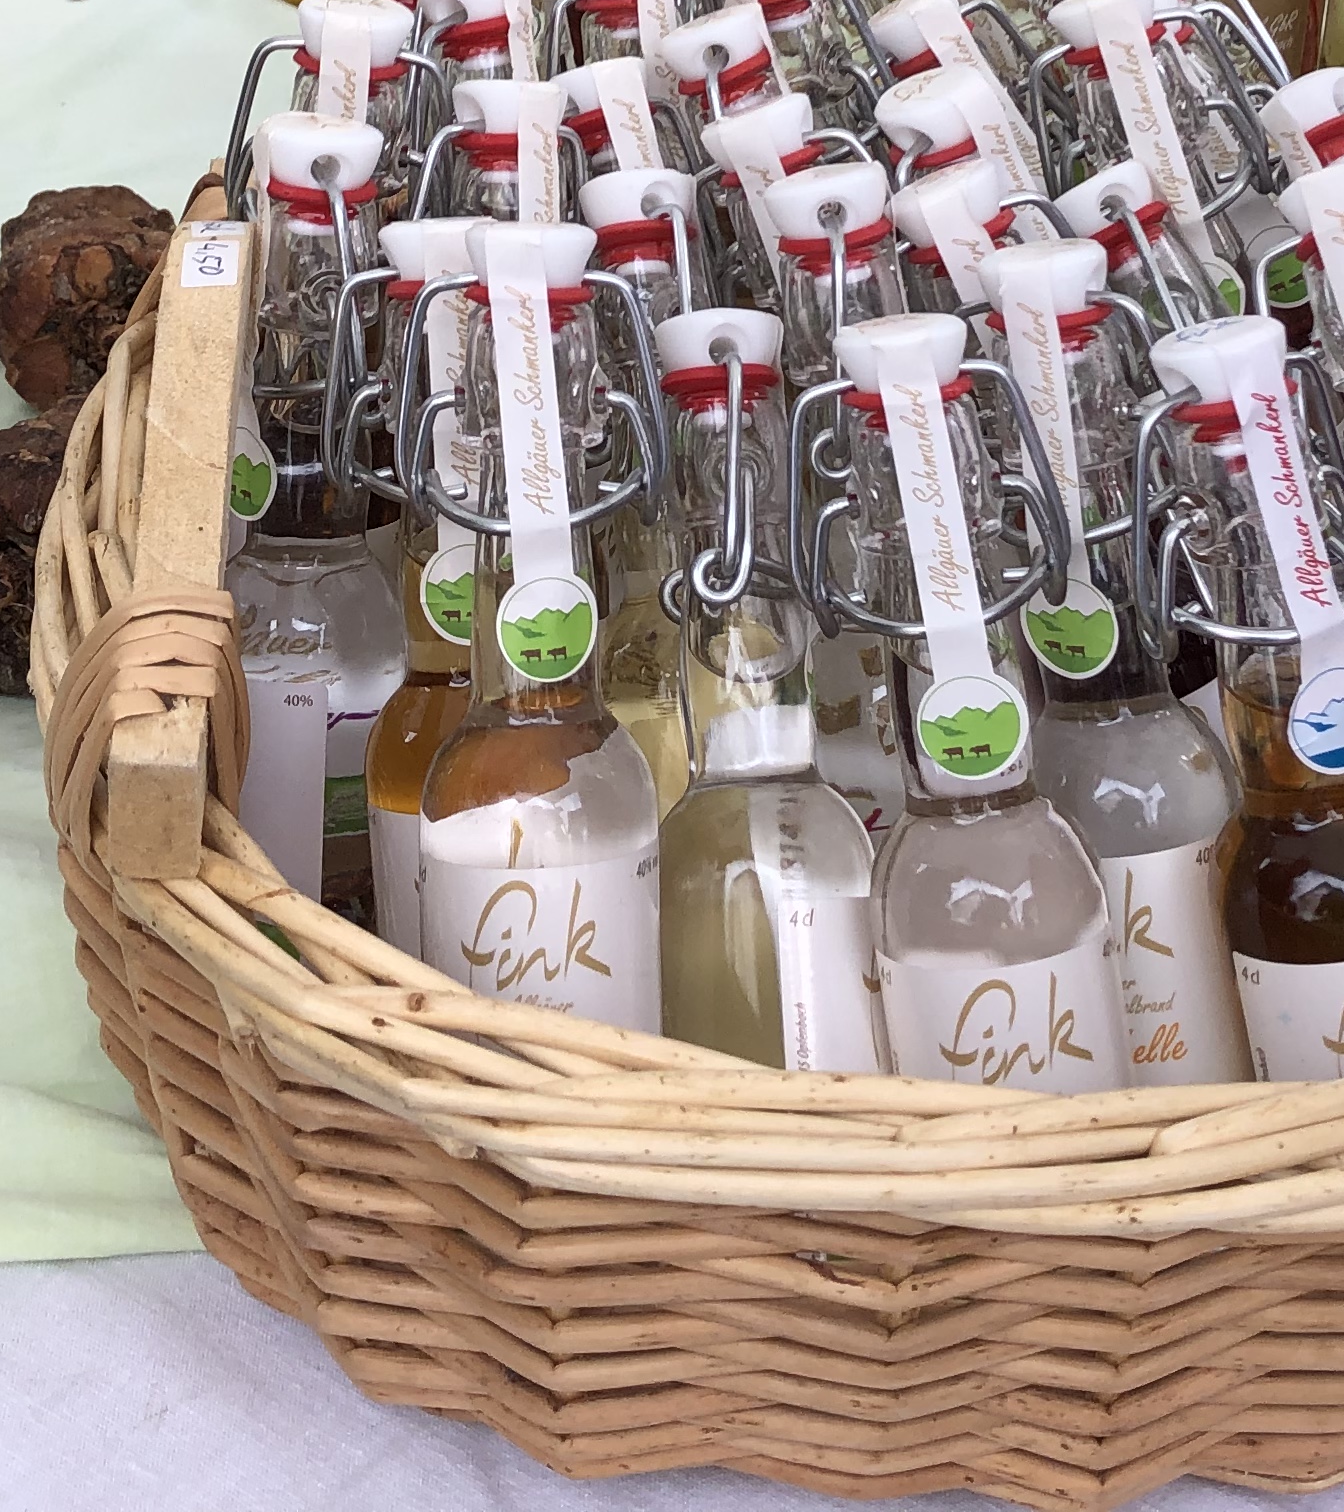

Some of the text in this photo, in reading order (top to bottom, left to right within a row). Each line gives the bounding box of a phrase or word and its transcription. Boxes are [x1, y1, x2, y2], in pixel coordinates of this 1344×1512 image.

[1108, 39, 1162, 136] Schmankerl
[504, 284, 562, 515] Allgäuer Schmankerl
[1021, 302, 1063, 422] Schmankerl
[898, 384, 971, 613] Allgäuer Schmankerl
[1250, 392, 1333, 609] Allgäuer Schmankerl
[283, 693, 314, 708] 40%
[460, 879, 612, 992] fink
[789, 910, 799, 927] 4
[939, 971, 1094, 1086] fink
